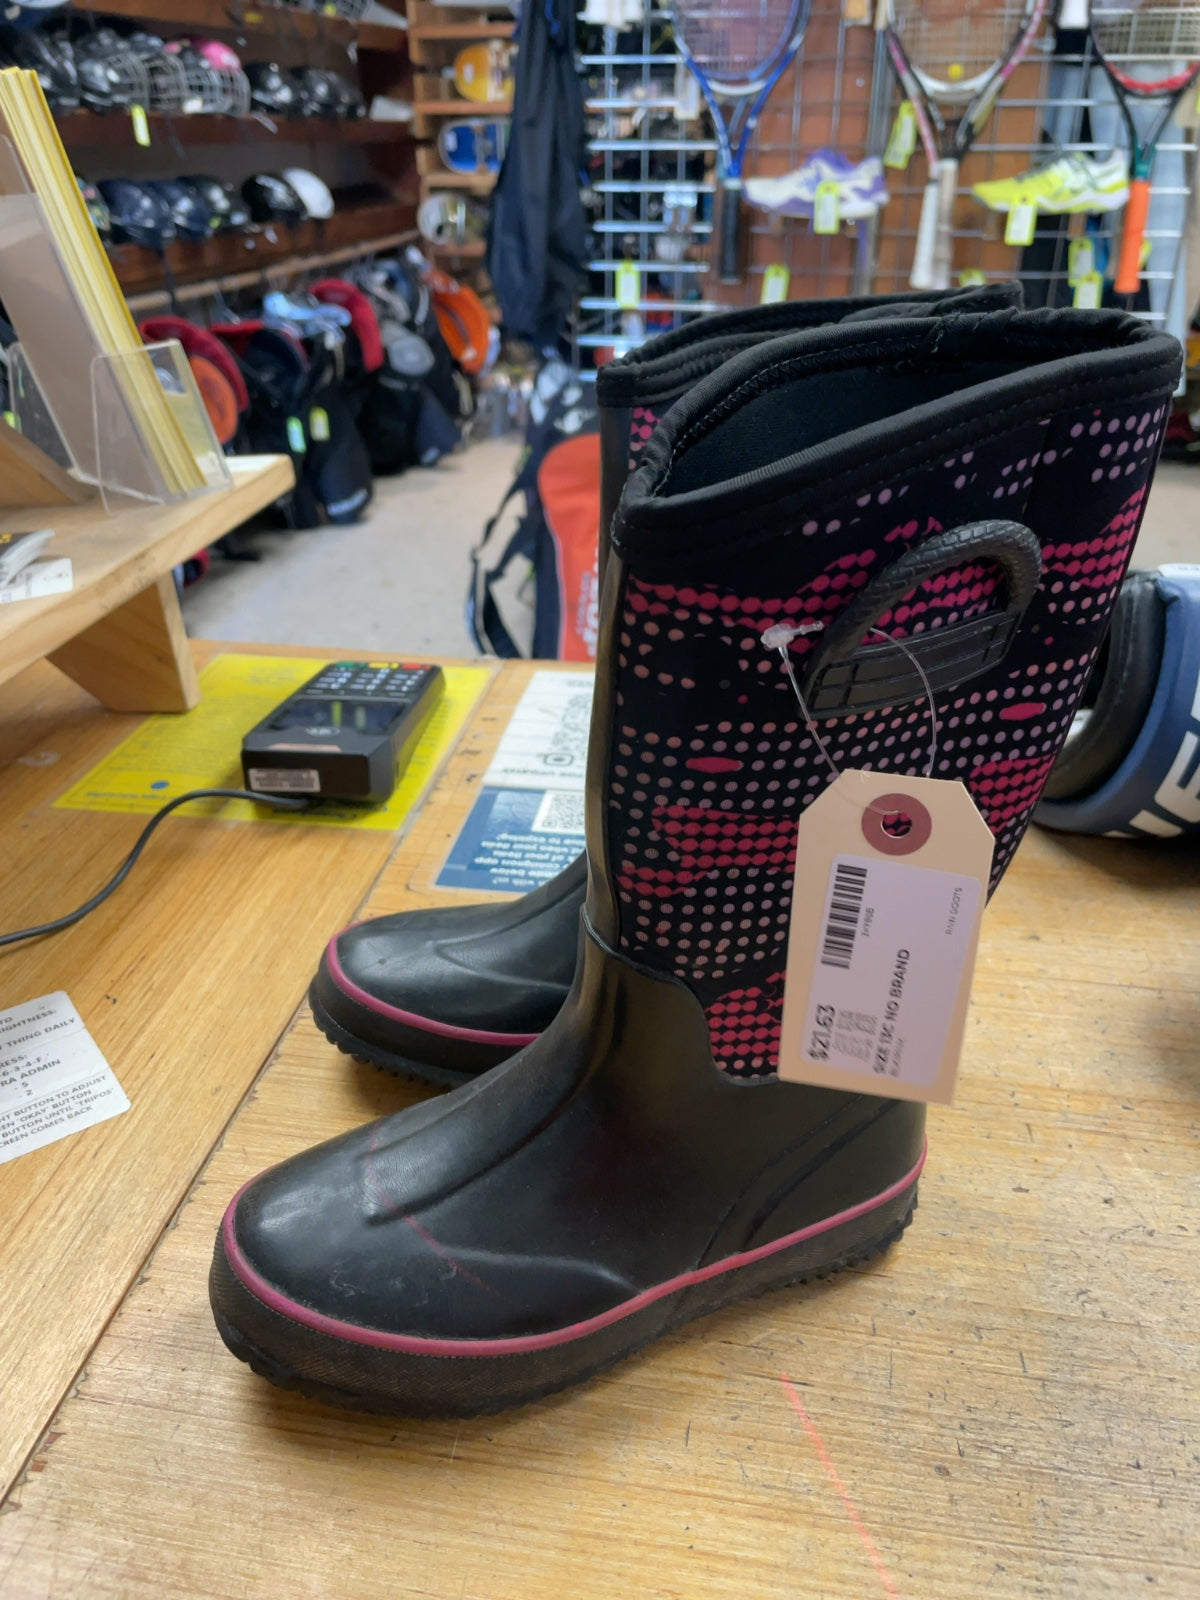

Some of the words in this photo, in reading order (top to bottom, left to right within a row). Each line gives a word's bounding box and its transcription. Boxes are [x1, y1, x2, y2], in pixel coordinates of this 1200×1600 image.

[889, 949, 911, 997] BRAND
[885, 1000, 899, 1023] NO
[6, 1031, 42, 1047] THING
[45, 1017, 75, 1033] DAILY
[20, 1058, 61, 1079] ADMIN
[14, 1096, 54, 1116] BUTTON
[55, 1090, 69, 1099] TO
[72, 1075, 106, 1093] ADJUST
[52, 1090, 92, 1109] BUTTON
[2, 1117, 43, 1138] BUTTON
[45, 1105, 73, 1120] UNTIL
[31, 1116, 65, 1134] COMES
[67, 1105, 93, 1119] BACK
